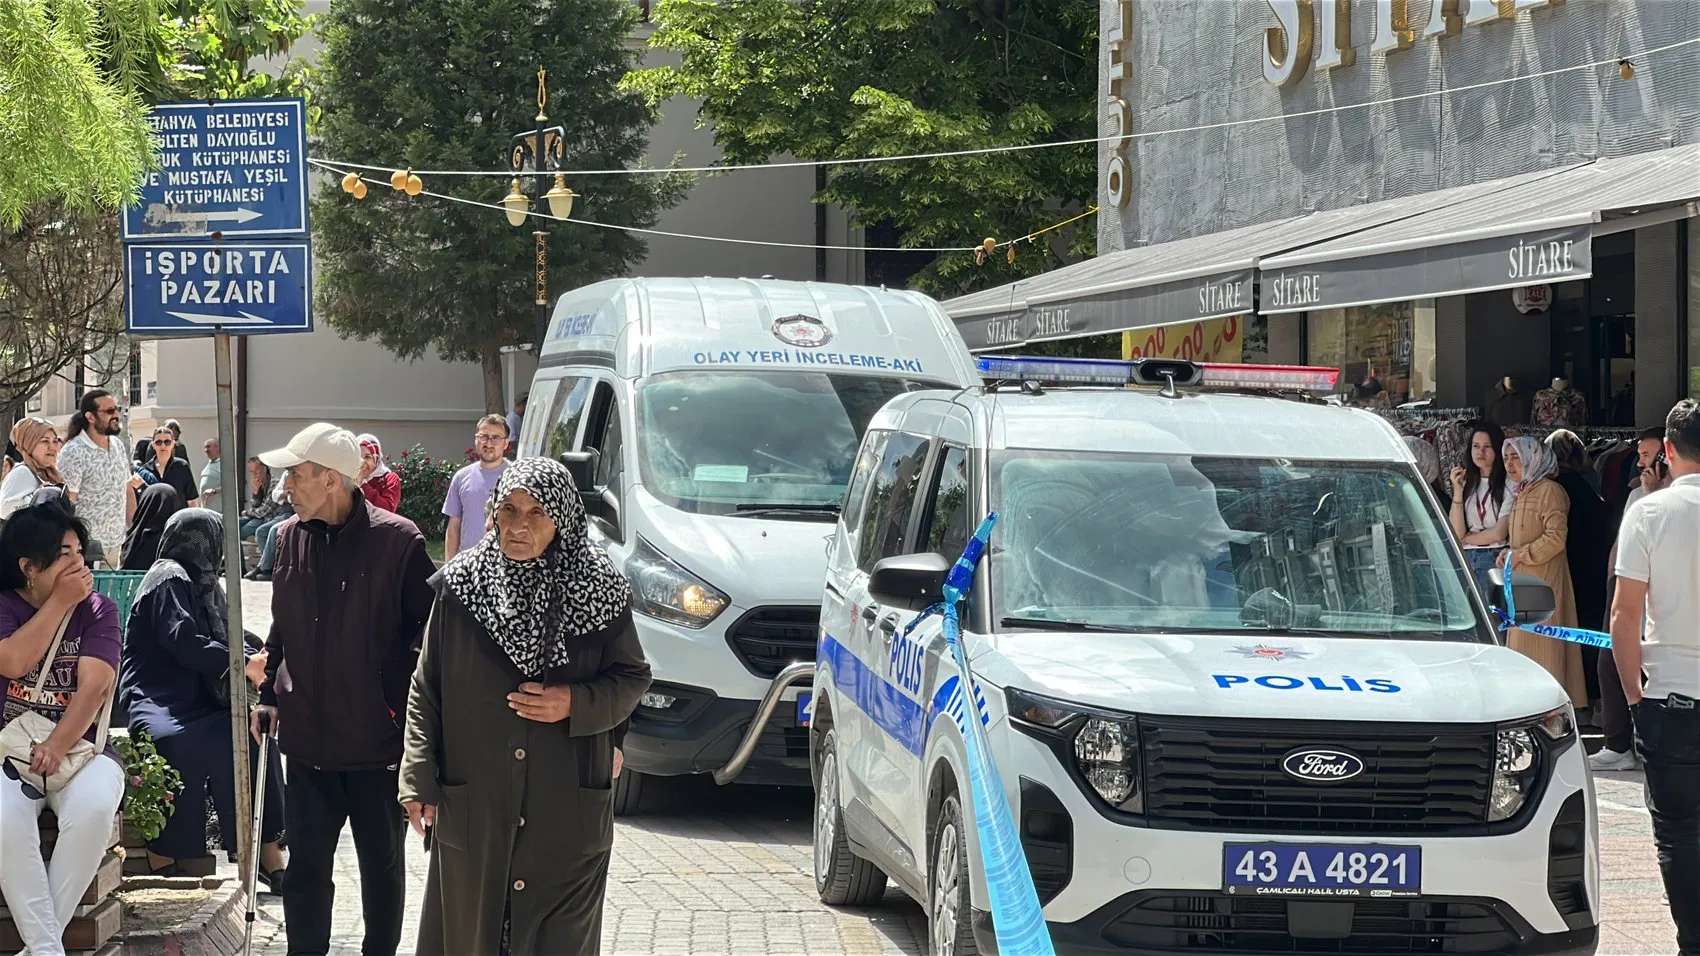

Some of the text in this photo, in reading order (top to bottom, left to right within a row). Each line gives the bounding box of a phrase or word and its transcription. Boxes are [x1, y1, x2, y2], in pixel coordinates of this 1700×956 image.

[149, 112, 289, 130] TAHYA BELEDİYESİ
[157, 130, 276, 148] ÜLTEN DAYIOĞLU
[192, 150, 290, 166] KÜTÜPHANESİ
[168, 169, 233, 186] MUSTAFA
[243, 168, 288, 187] YEŞİL
[164, 188, 264, 205] KÜTÜPHANESİ
[145, 250, 290, 280] İŞPORTA
[1508, 239, 1574, 279] SİTARE
[161, 280, 276, 304] PAZARI
[1199, 280, 1242, 314] SİTARE
[1272, 271, 1320, 306] SİTARE
[987, 316, 1019, 344] SİTARE
[1036, 307, 1070, 335] SİTARE
[694, 349, 924, 373] OLAY YERİ İNCELEME-AKİ
[889, 631, 924, 695] POLİS
[1212, 675, 1401, 693] POLİS
[1299, 754, 1348, 776] Ford
[1235, 850, 1407, 884] 43 A 4821
[1256, 887, 1306, 895] ÇAMLICALI
